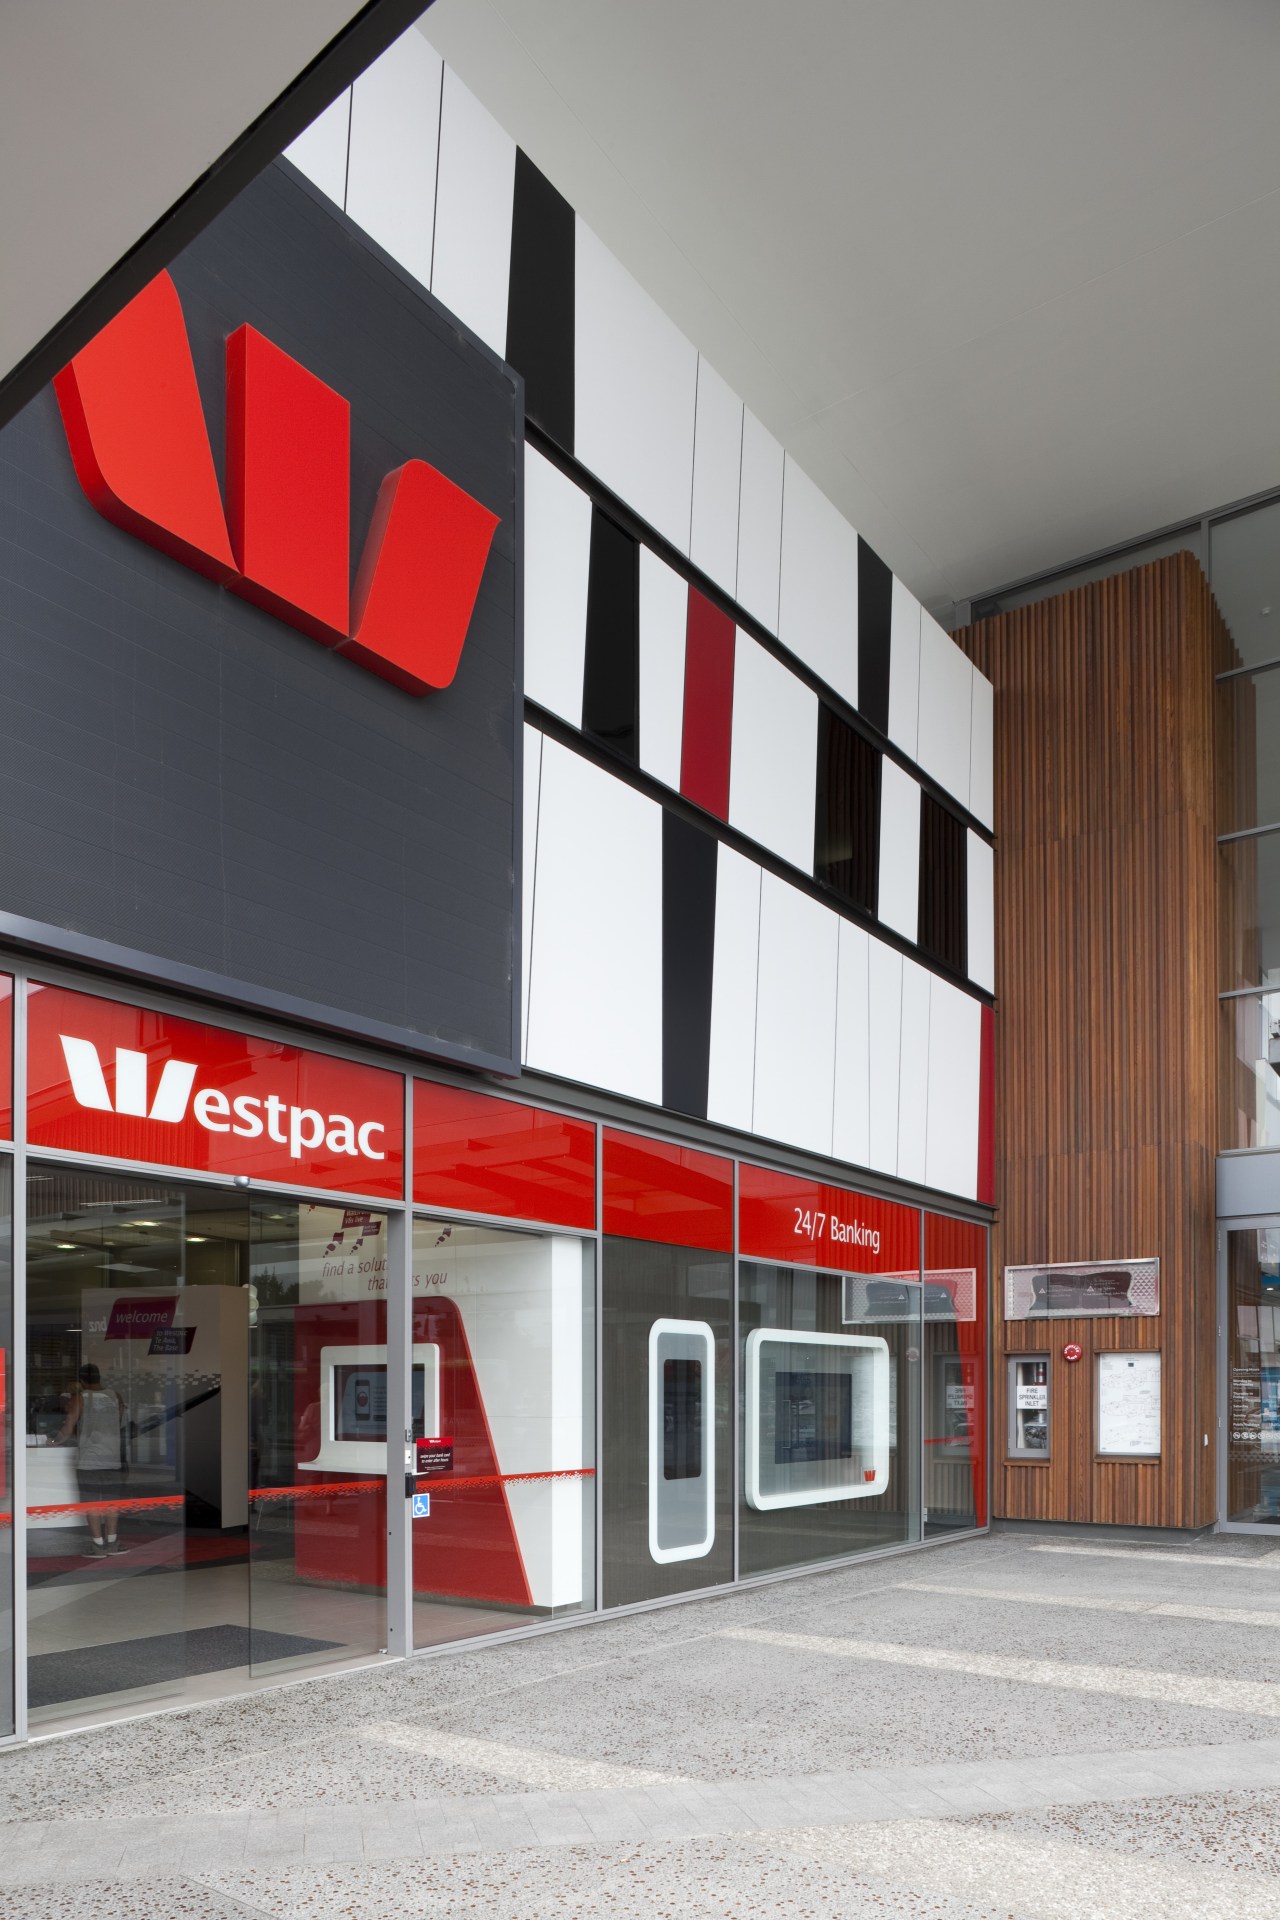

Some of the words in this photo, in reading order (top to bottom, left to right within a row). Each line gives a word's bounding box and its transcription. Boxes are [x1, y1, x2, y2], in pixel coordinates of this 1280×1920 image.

[58, 1033, 385, 1159] Westpac
[794, 1208, 826, 1240] 24/7
[831, 1216, 880, 1254] Banking
[322, 1261, 345, 1277] find
[347, 1264, 354, 1274] a
[357, 1257, 387, 1273] solut
[425, 1272, 448, 1288] you
[116, 1311, 168, 1323] welcome
